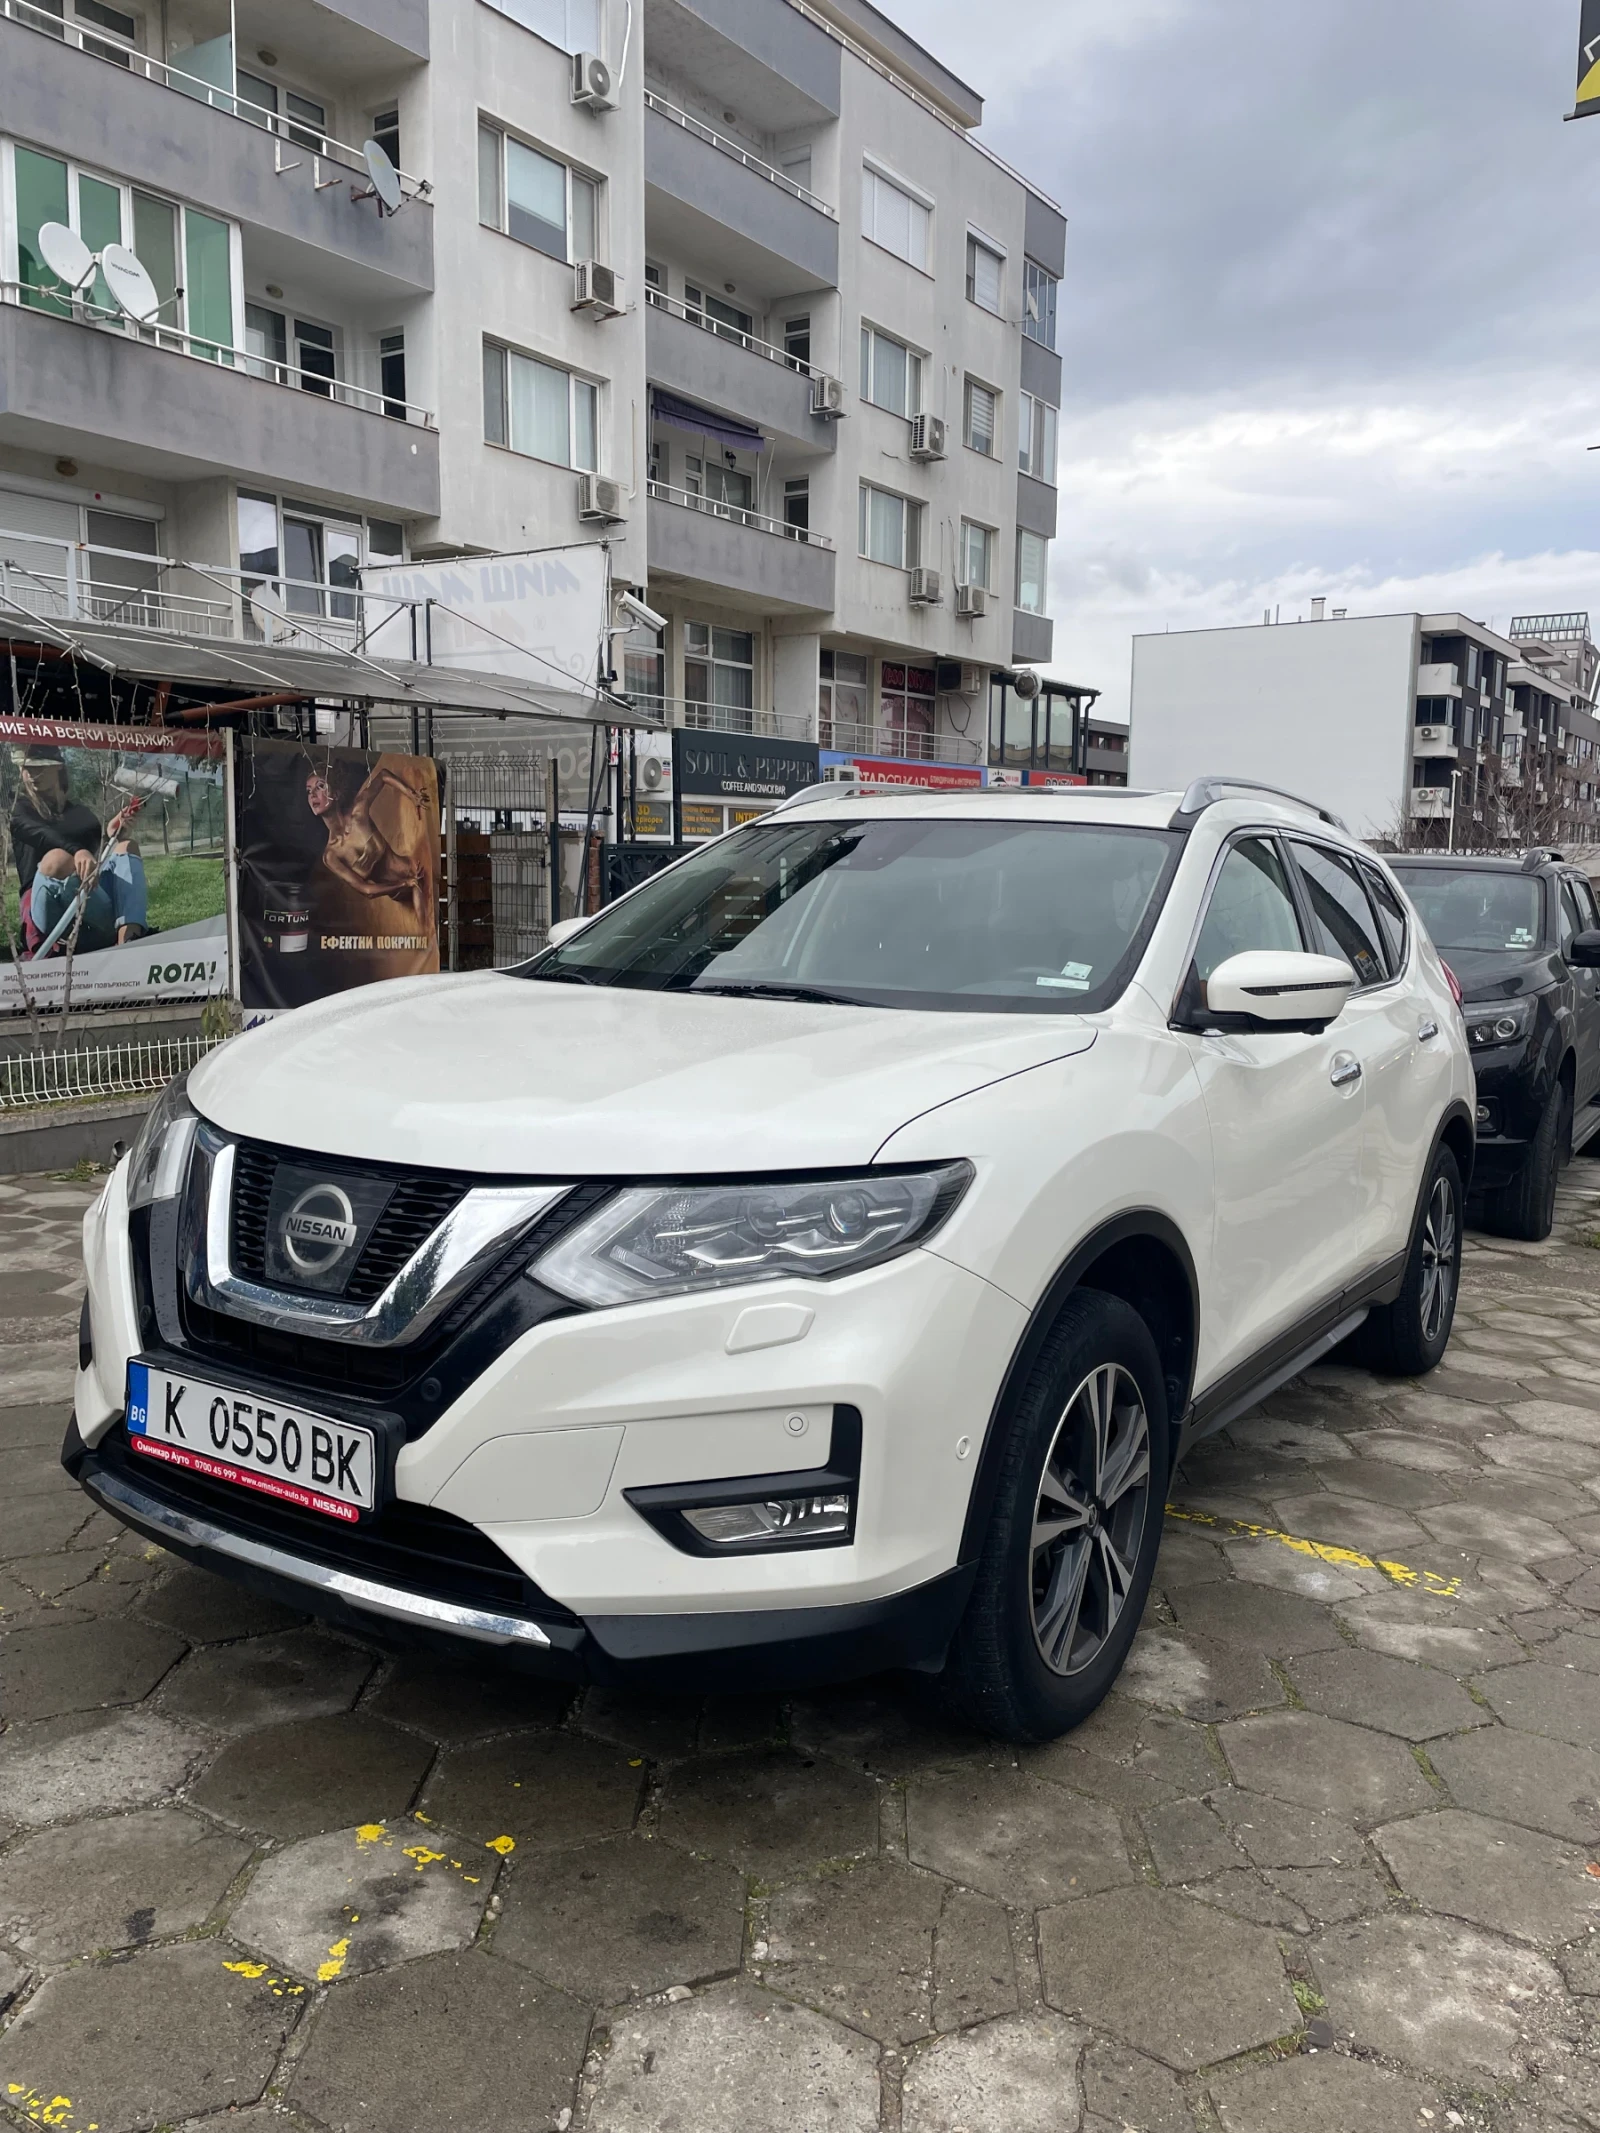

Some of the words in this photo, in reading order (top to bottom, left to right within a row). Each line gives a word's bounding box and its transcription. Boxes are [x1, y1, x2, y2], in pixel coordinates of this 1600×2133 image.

[30, 724, 54, 738] НА
[56, 726, 104, 742] ВСЕКИ
[107, 730, 174, 748] БОЯДЖИЯ
[685, 749, 732, 777] SOUL
[737, 753, 750, 778] &
[755, 757, 816, 783] PEPPER
[722, 780, 744, 792] COFFEE
[744, 782, 757, 793] AND
[757, 783, 775, 794] SNACK
[775, 785, 787, 796] BAR
[637, 804, 651, 816] 3D
[320, 935, 373, 950] ЕФЕКТНИ
[376, 935, 428, 950] ПОКРИТИЯ
[3, 974, 40, 982] ЗИДРСКИ
[40, 970, 89, 979] ИНСТРУЕНТИ
[36, 985, 59, 993] МАЛКИ
[68, 983, 93, 991] ОЛЕМИ
[94, 980, 141, 989] ПОВЪРХНОСТИ
[285, 1217, 347, 1241] NISSAN
[130, 1405, 146, 1424] BG
[165, 1381, 187, 1440] K
[136, 1440, 170, 1461] Омникар
[171, 1450, 190, 1466] Ауто
[195, 1460, 212, 1474] 0700
[213, 1465, 222, 1476] 45
[222, 1467, 237, 1480] 999
[241, 1475, 309, 1505] www.omnicar-auto.bg
[312, 1497, 352, 1519] NISSAN
